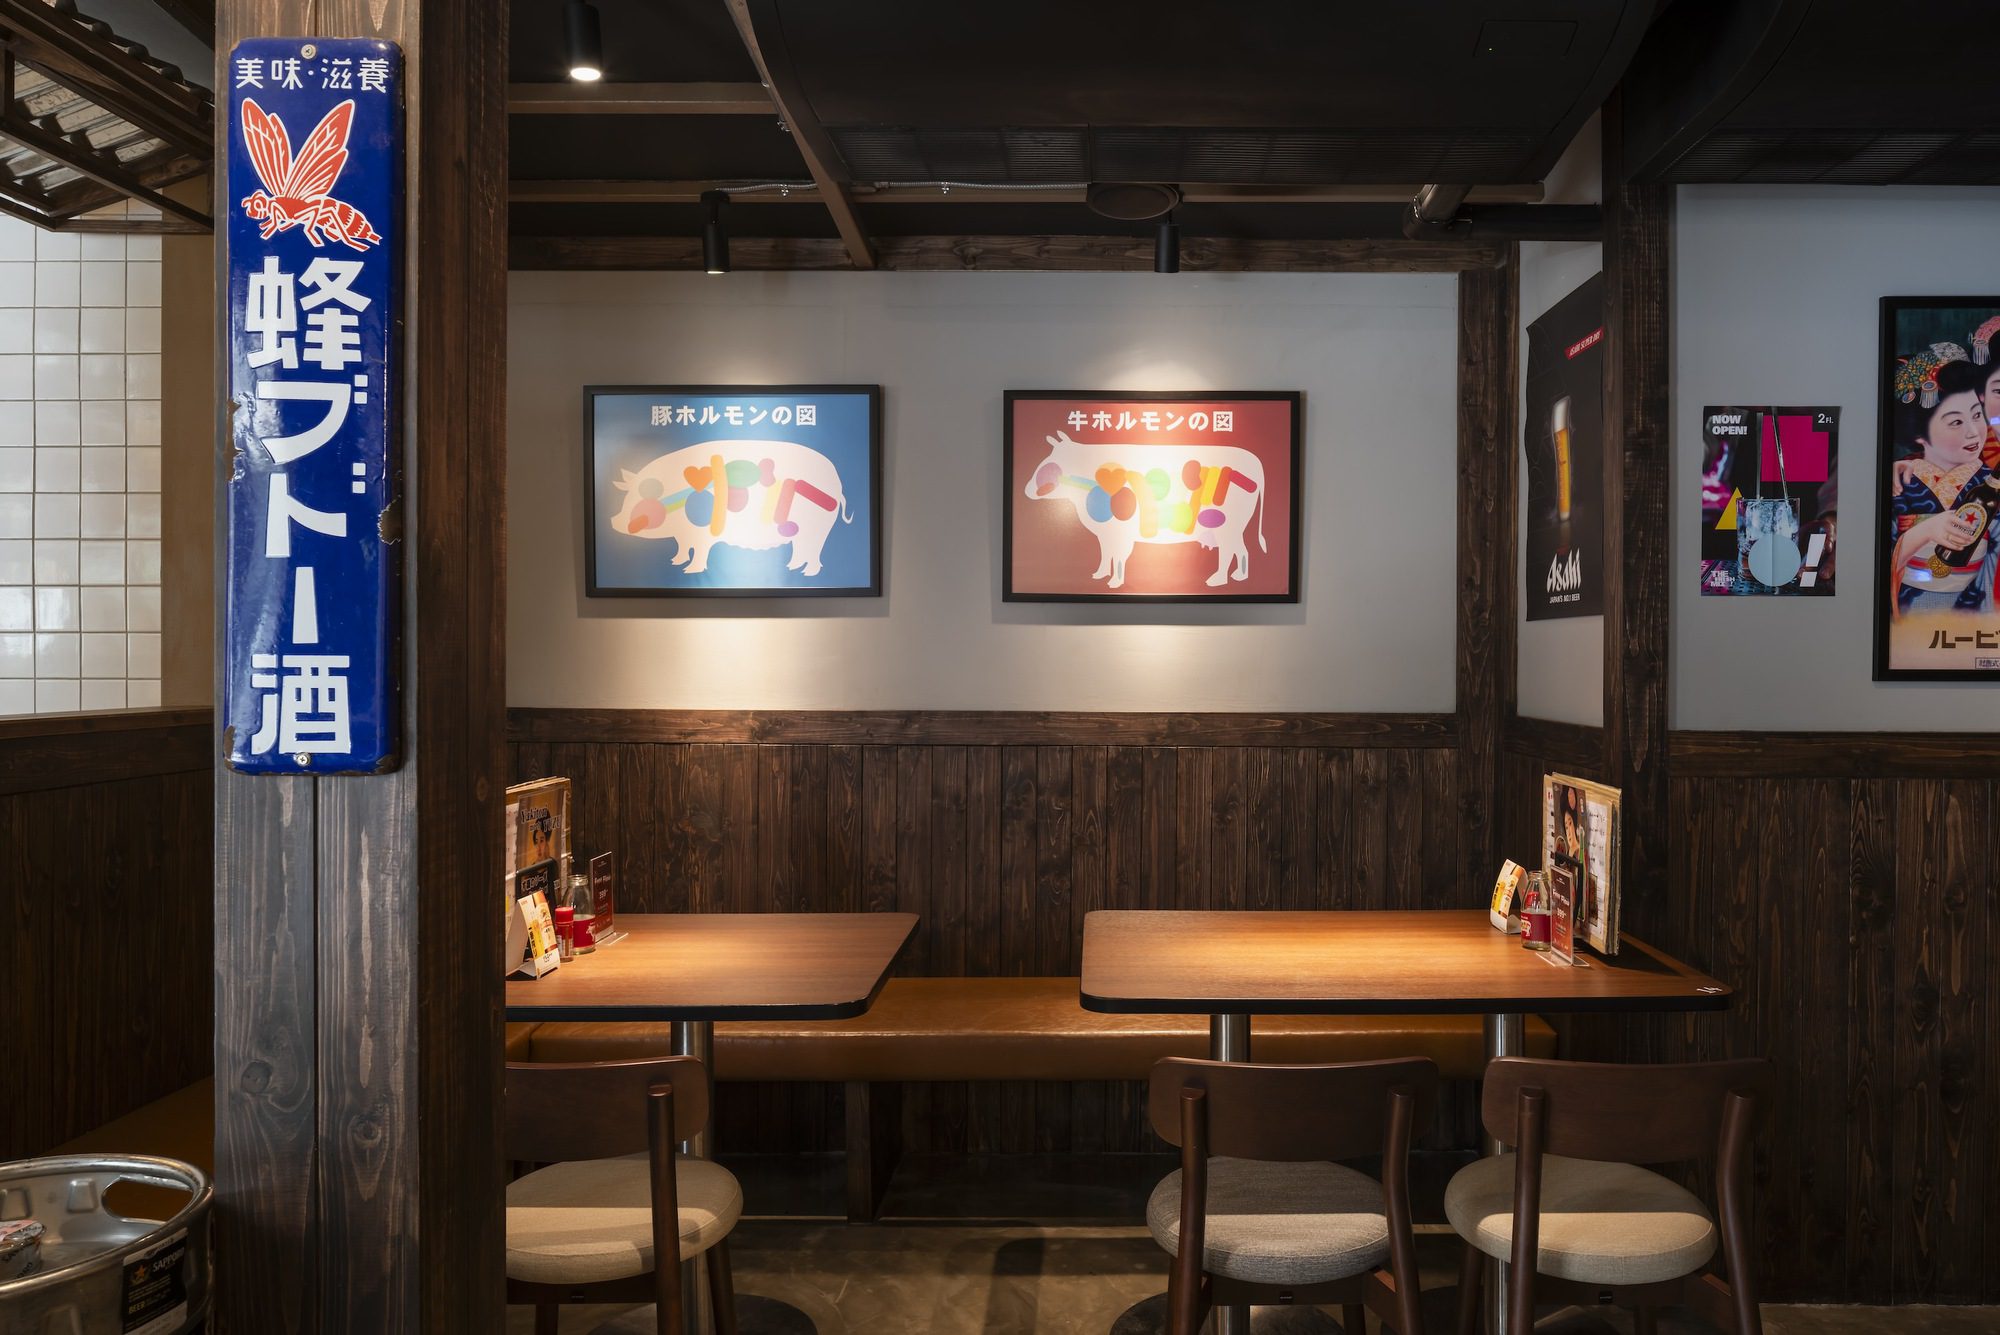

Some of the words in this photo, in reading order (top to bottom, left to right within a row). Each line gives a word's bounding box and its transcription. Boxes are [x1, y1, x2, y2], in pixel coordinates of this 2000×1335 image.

[651, 405, 817, 426] 豚ホルモンの図
[1067, 410, 1233, 432] 牛ホルモンの図
[1712, 415, 1742, 424] NOW
[1712, 426, 1748, 435] OPEN!
[245, 256, 372, 755] 蜂ブドー酒
[152, 1247, 185, 1273] SAPPO
